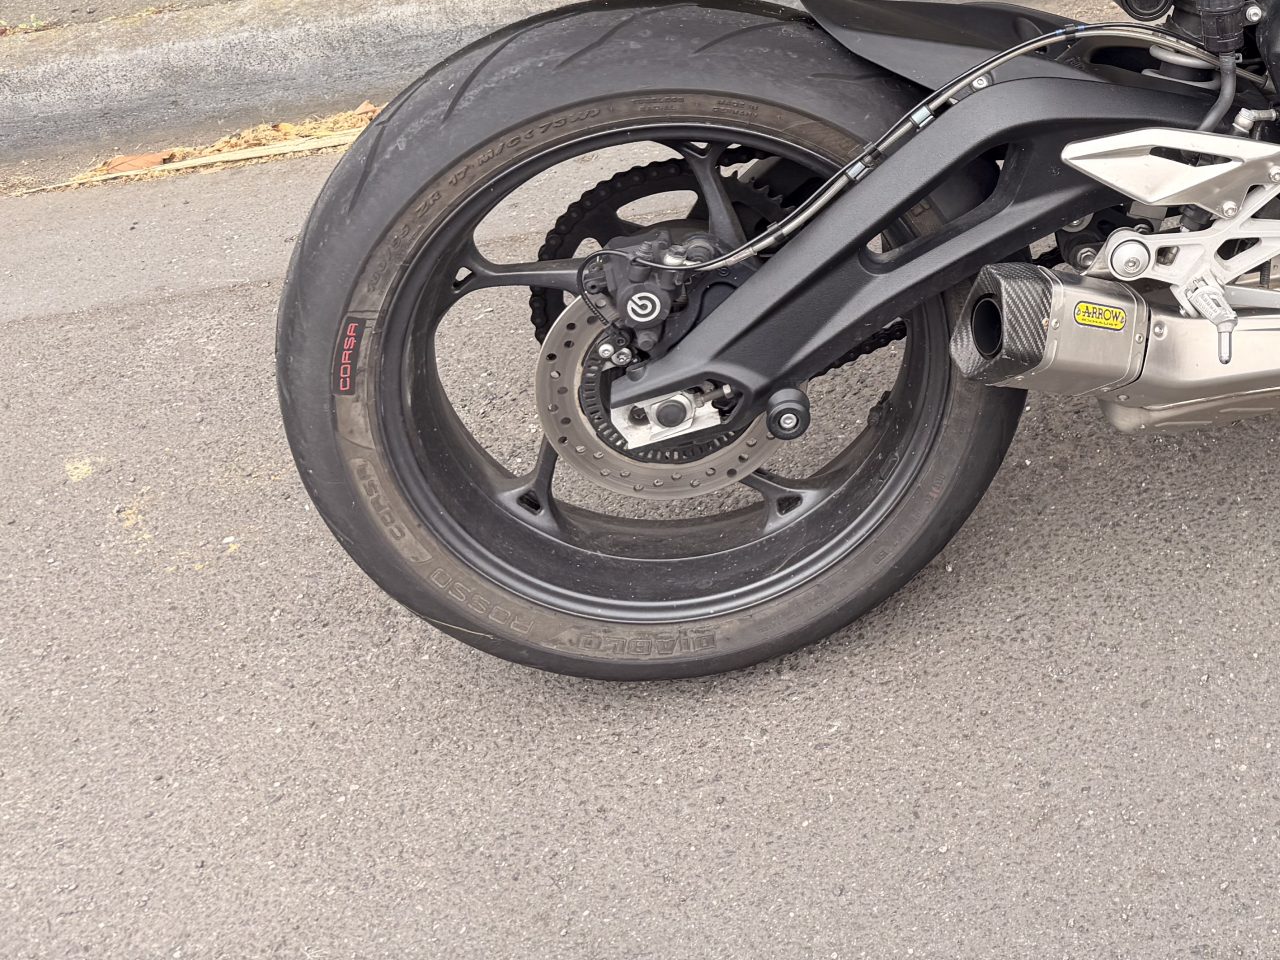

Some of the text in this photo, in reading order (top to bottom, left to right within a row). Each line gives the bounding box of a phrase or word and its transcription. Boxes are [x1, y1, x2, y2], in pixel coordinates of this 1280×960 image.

[1081, 305, 1121, 323] ARROW
[340, 322, 359, 391] CORSA
[429, 567, 536, 635] ROSSO
